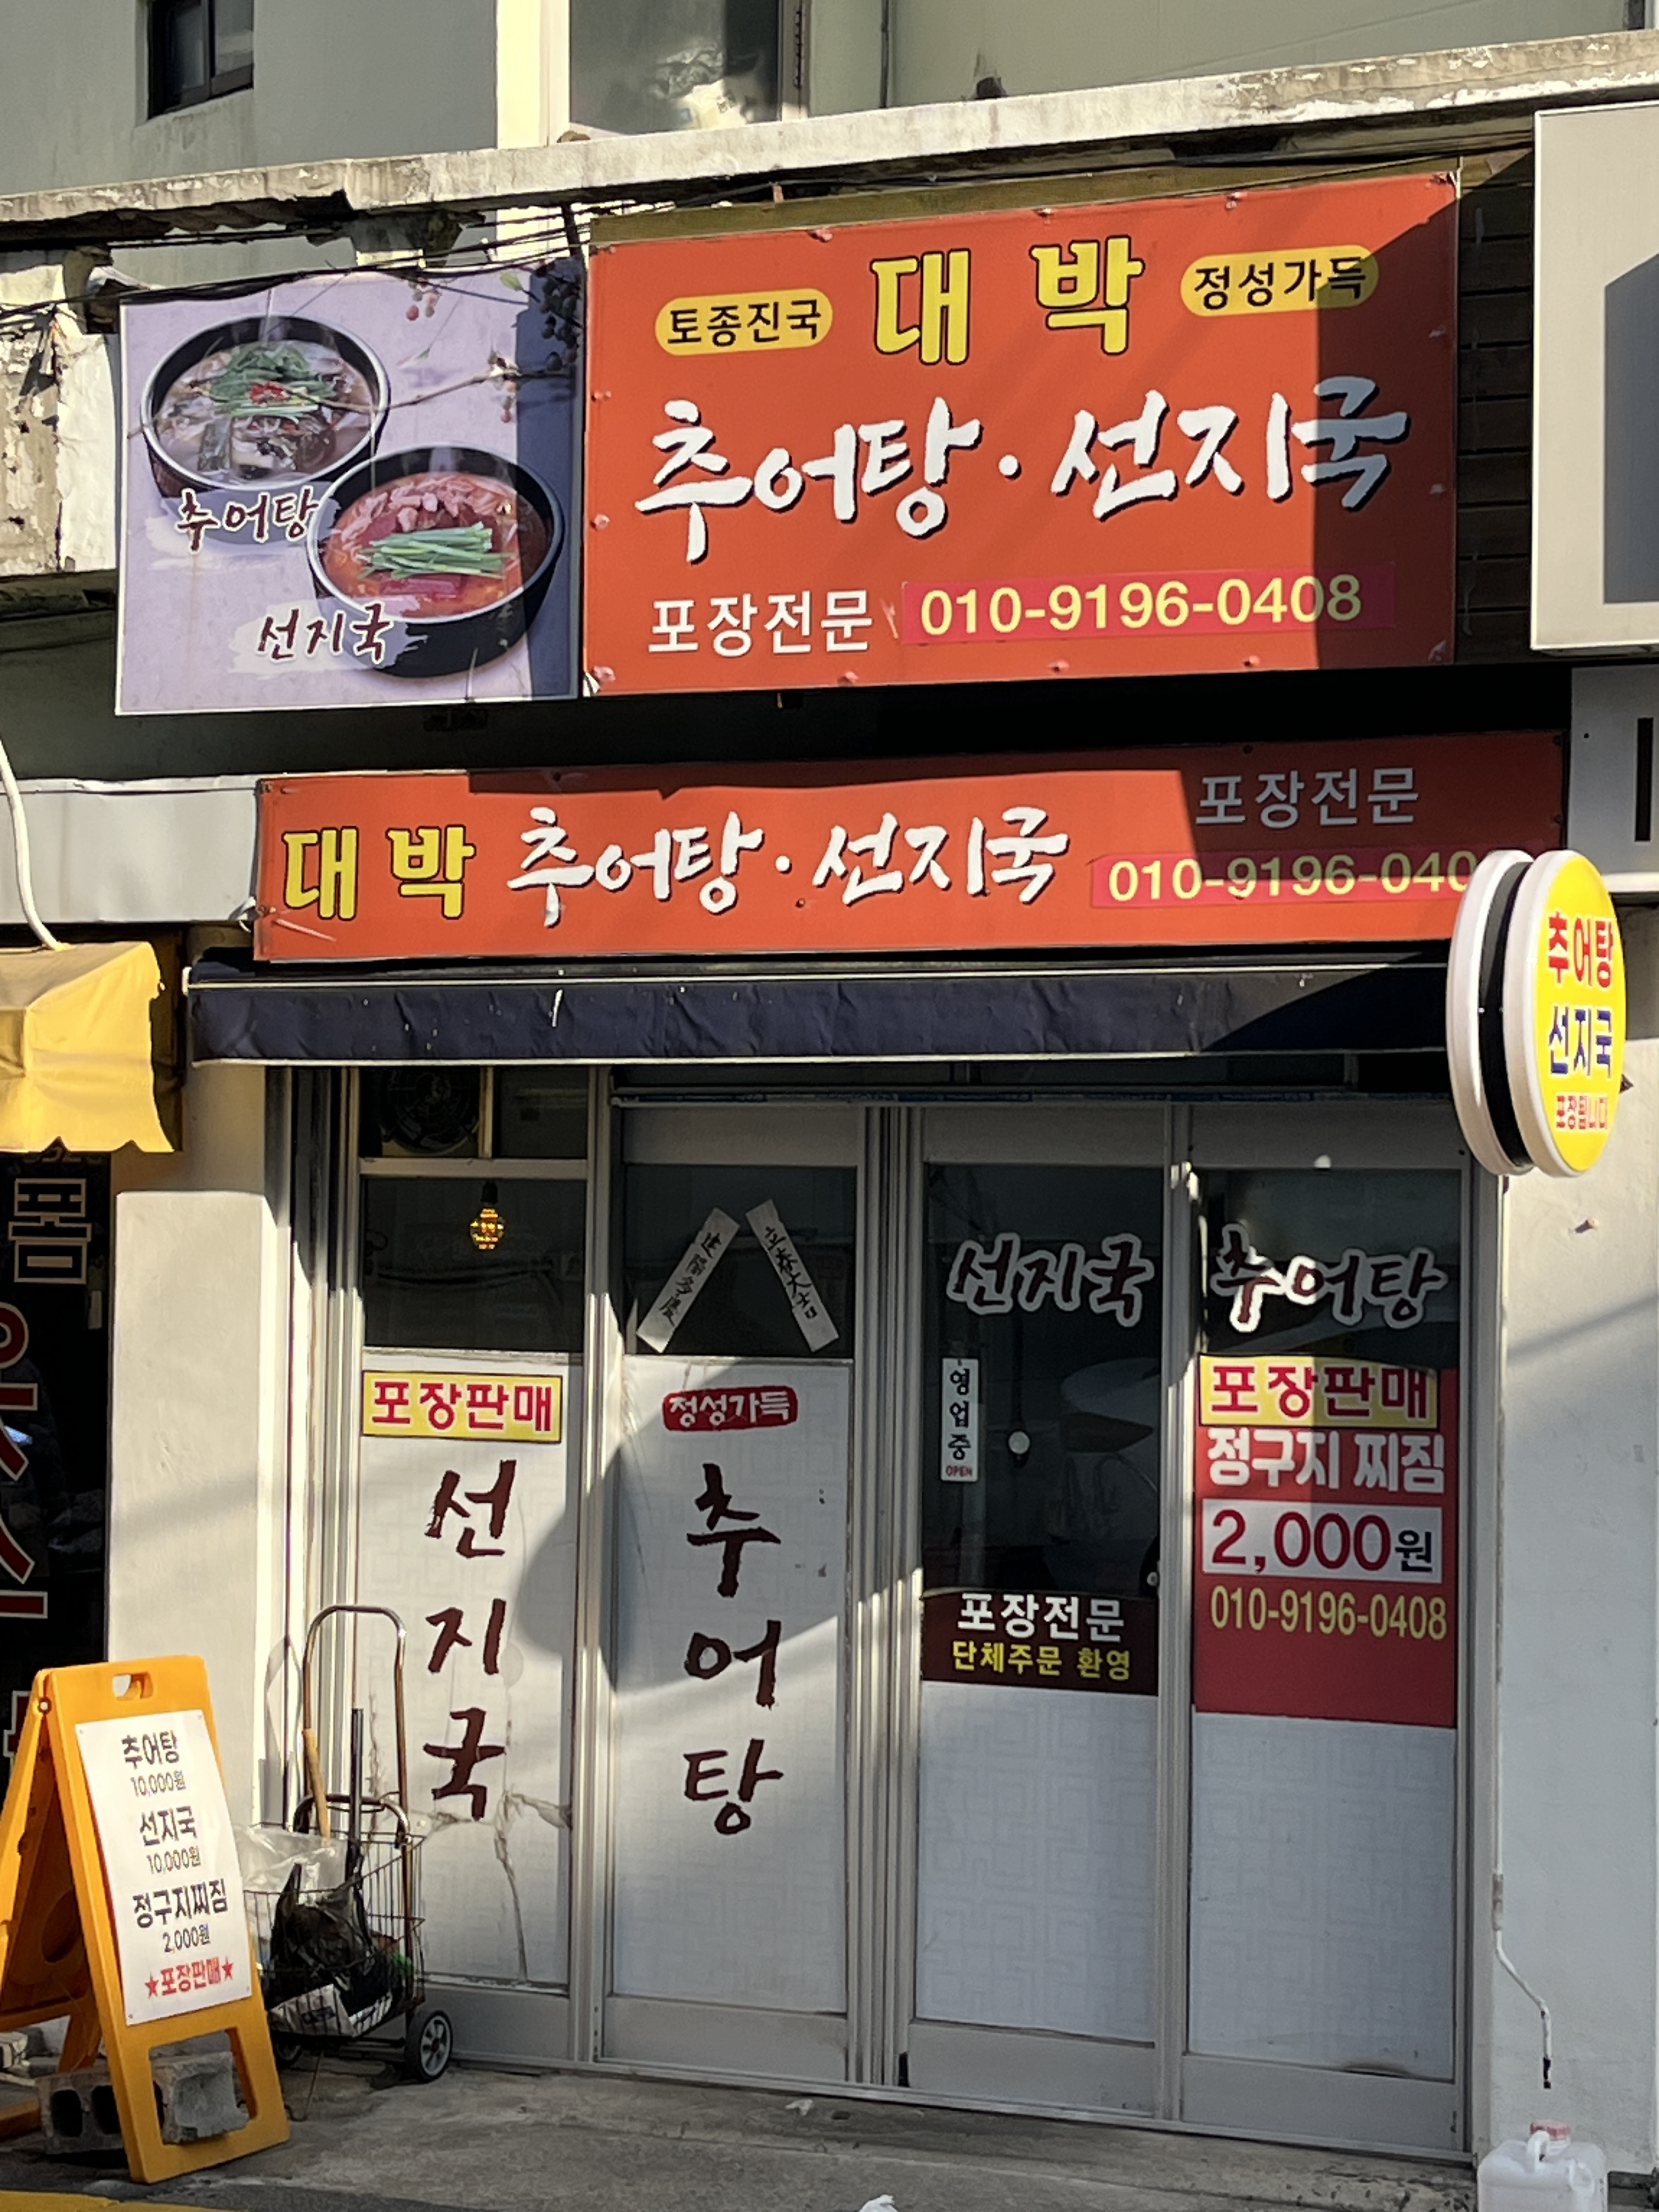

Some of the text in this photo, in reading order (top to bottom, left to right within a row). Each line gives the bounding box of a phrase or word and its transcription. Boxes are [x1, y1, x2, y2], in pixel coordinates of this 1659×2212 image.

[1194, 254, 1369, 314] 정성가득
[666, 296, 822, 347] 토종진국
[177, 487, 318, 552] 추어탕
[258, 602, 394, 663] 선지국
[647, 591, 873, 657] 포장전문
[919, 575, 1363, 637] 010-9196-0408
[1194, 766, 1420, 827] 포장전문
[281, 824, 477, 919] 대박
[1108, 850, 1477, 900] 010-9196-040
[1548, 911, 1613, 989] 추어탕
[1549, 1006, 1613, 1078] 선지국
[947, 1233, 1154, 1327] 선지국
[1210, 1222, 1448, 1333] 추어탕
[371, 1380, 553, 1432] 포장판매
[669, 1391, 790, 1427] 정성가득
[949, 1368, 971, 1461] 영업중
[1211, 1365, 1426, 1419] 포장판매
[945, 1465, 973, 1477] OPEN
[1207, 1427, 1444, 1493] 정구지 찌짐
[1212, 1509, 1432, 1573] 2,000원
[422, 1459, 517, 1820] 선지국
[957, 1593, 1124, 1643] 포장전문
[1211, 1585, 1447, 1640] 010-9196-0408
[684, 1463, 784, 1835] 추어탕
[952, 1640, 1130, 1681] 단체주문 환영
[122, 1730, 179, 1769] 추어탕
[131, 1770, 186, 1797] 10,000원
[140, 1805, 198, 1847] 선지국
[146, 1845, 201, 1874] 10,000원
[133, 1878, 228, 1928] 정구지찌짐
[163, 1923, 211, 1953] 2,000원
